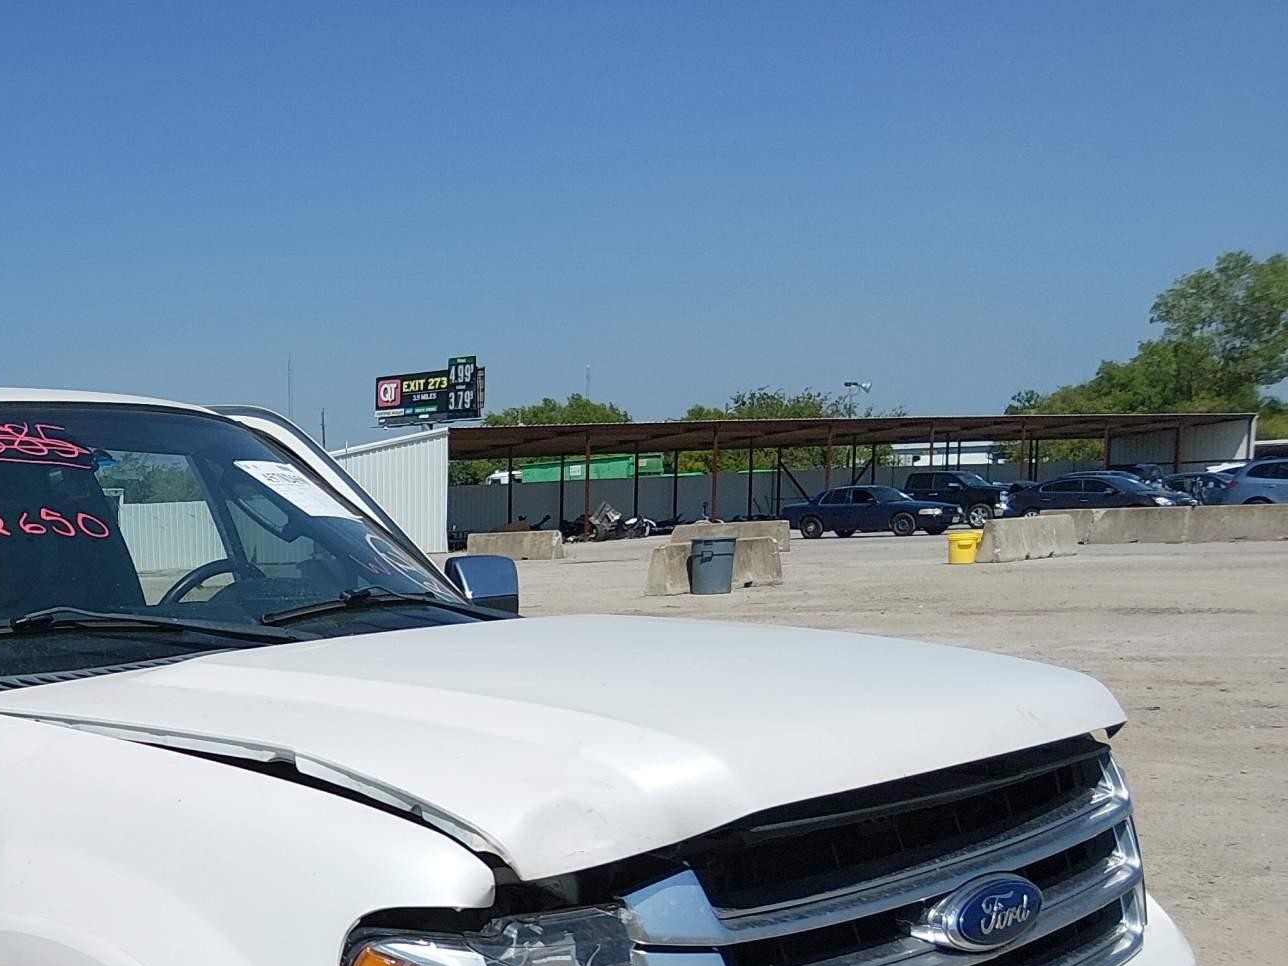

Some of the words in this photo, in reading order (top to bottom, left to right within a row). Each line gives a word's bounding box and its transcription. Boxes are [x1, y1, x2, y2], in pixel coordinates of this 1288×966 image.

[402, 379, 427, 392] EXIT
[428, 377, 448, 389] 273
[380, 384, 398, 402] QT
[421, 392, 437, 400] MILES
[979, 890, 1032, 935] Ford
